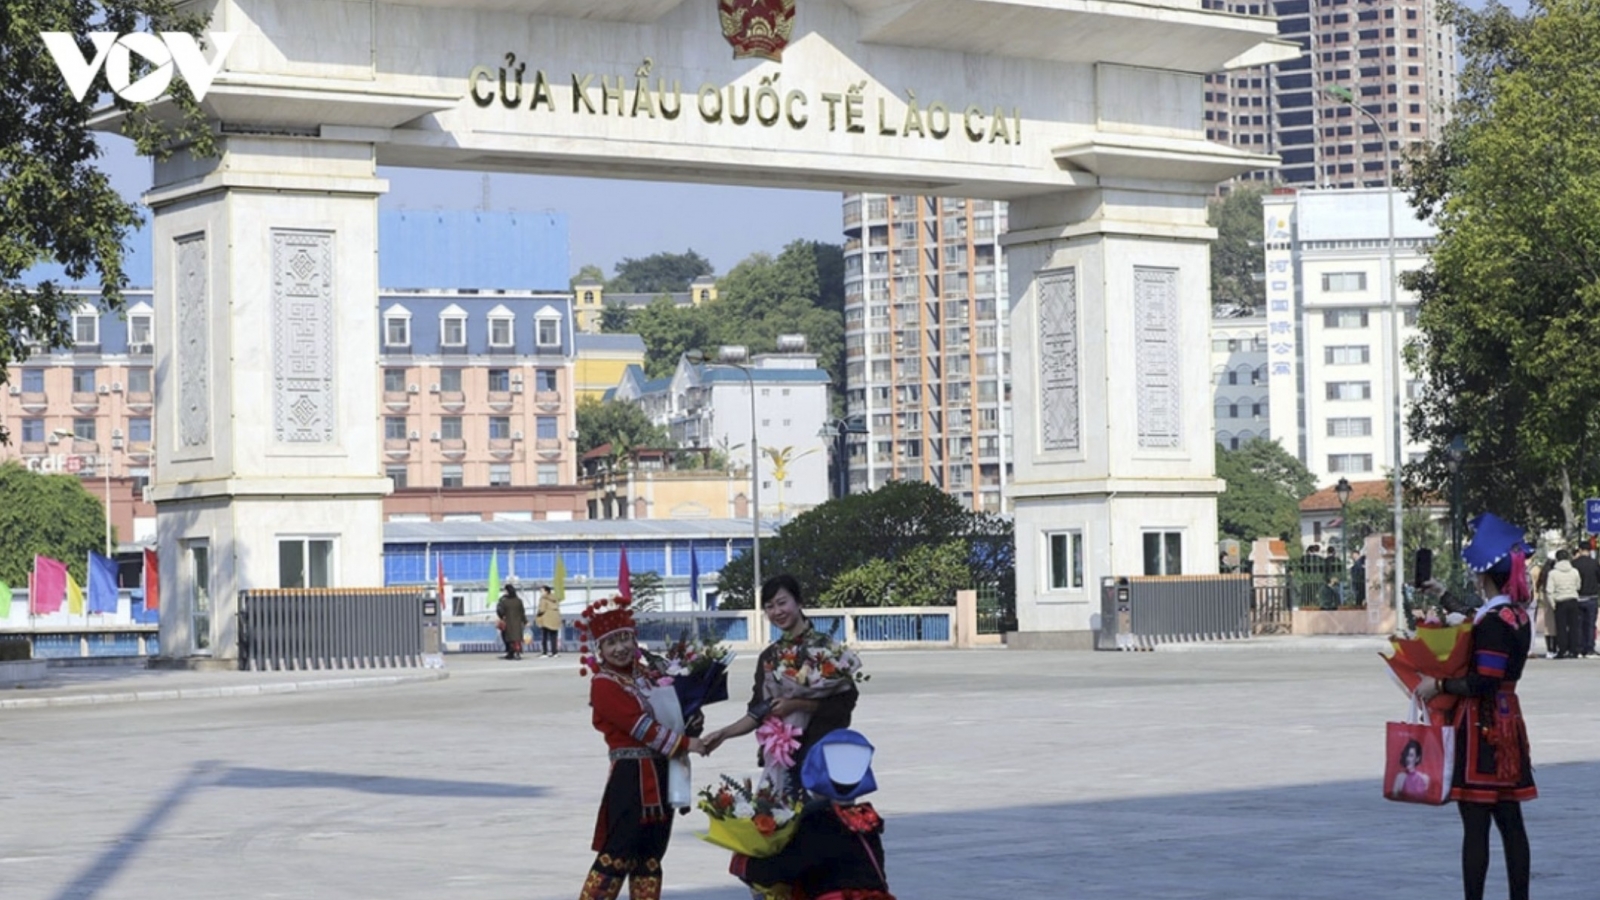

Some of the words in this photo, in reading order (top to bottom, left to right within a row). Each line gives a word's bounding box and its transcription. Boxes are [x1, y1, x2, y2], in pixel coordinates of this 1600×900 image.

[469, 52, 555, 111] CỬA
[571, 57, 681, 120] KHẨU
[697, 72, 808, 131] QUỐC
[821, 80, 868, 134] TẾ
[878, 87, 950, 140] LÀO
[963, 102, 1021, 146] CAI
